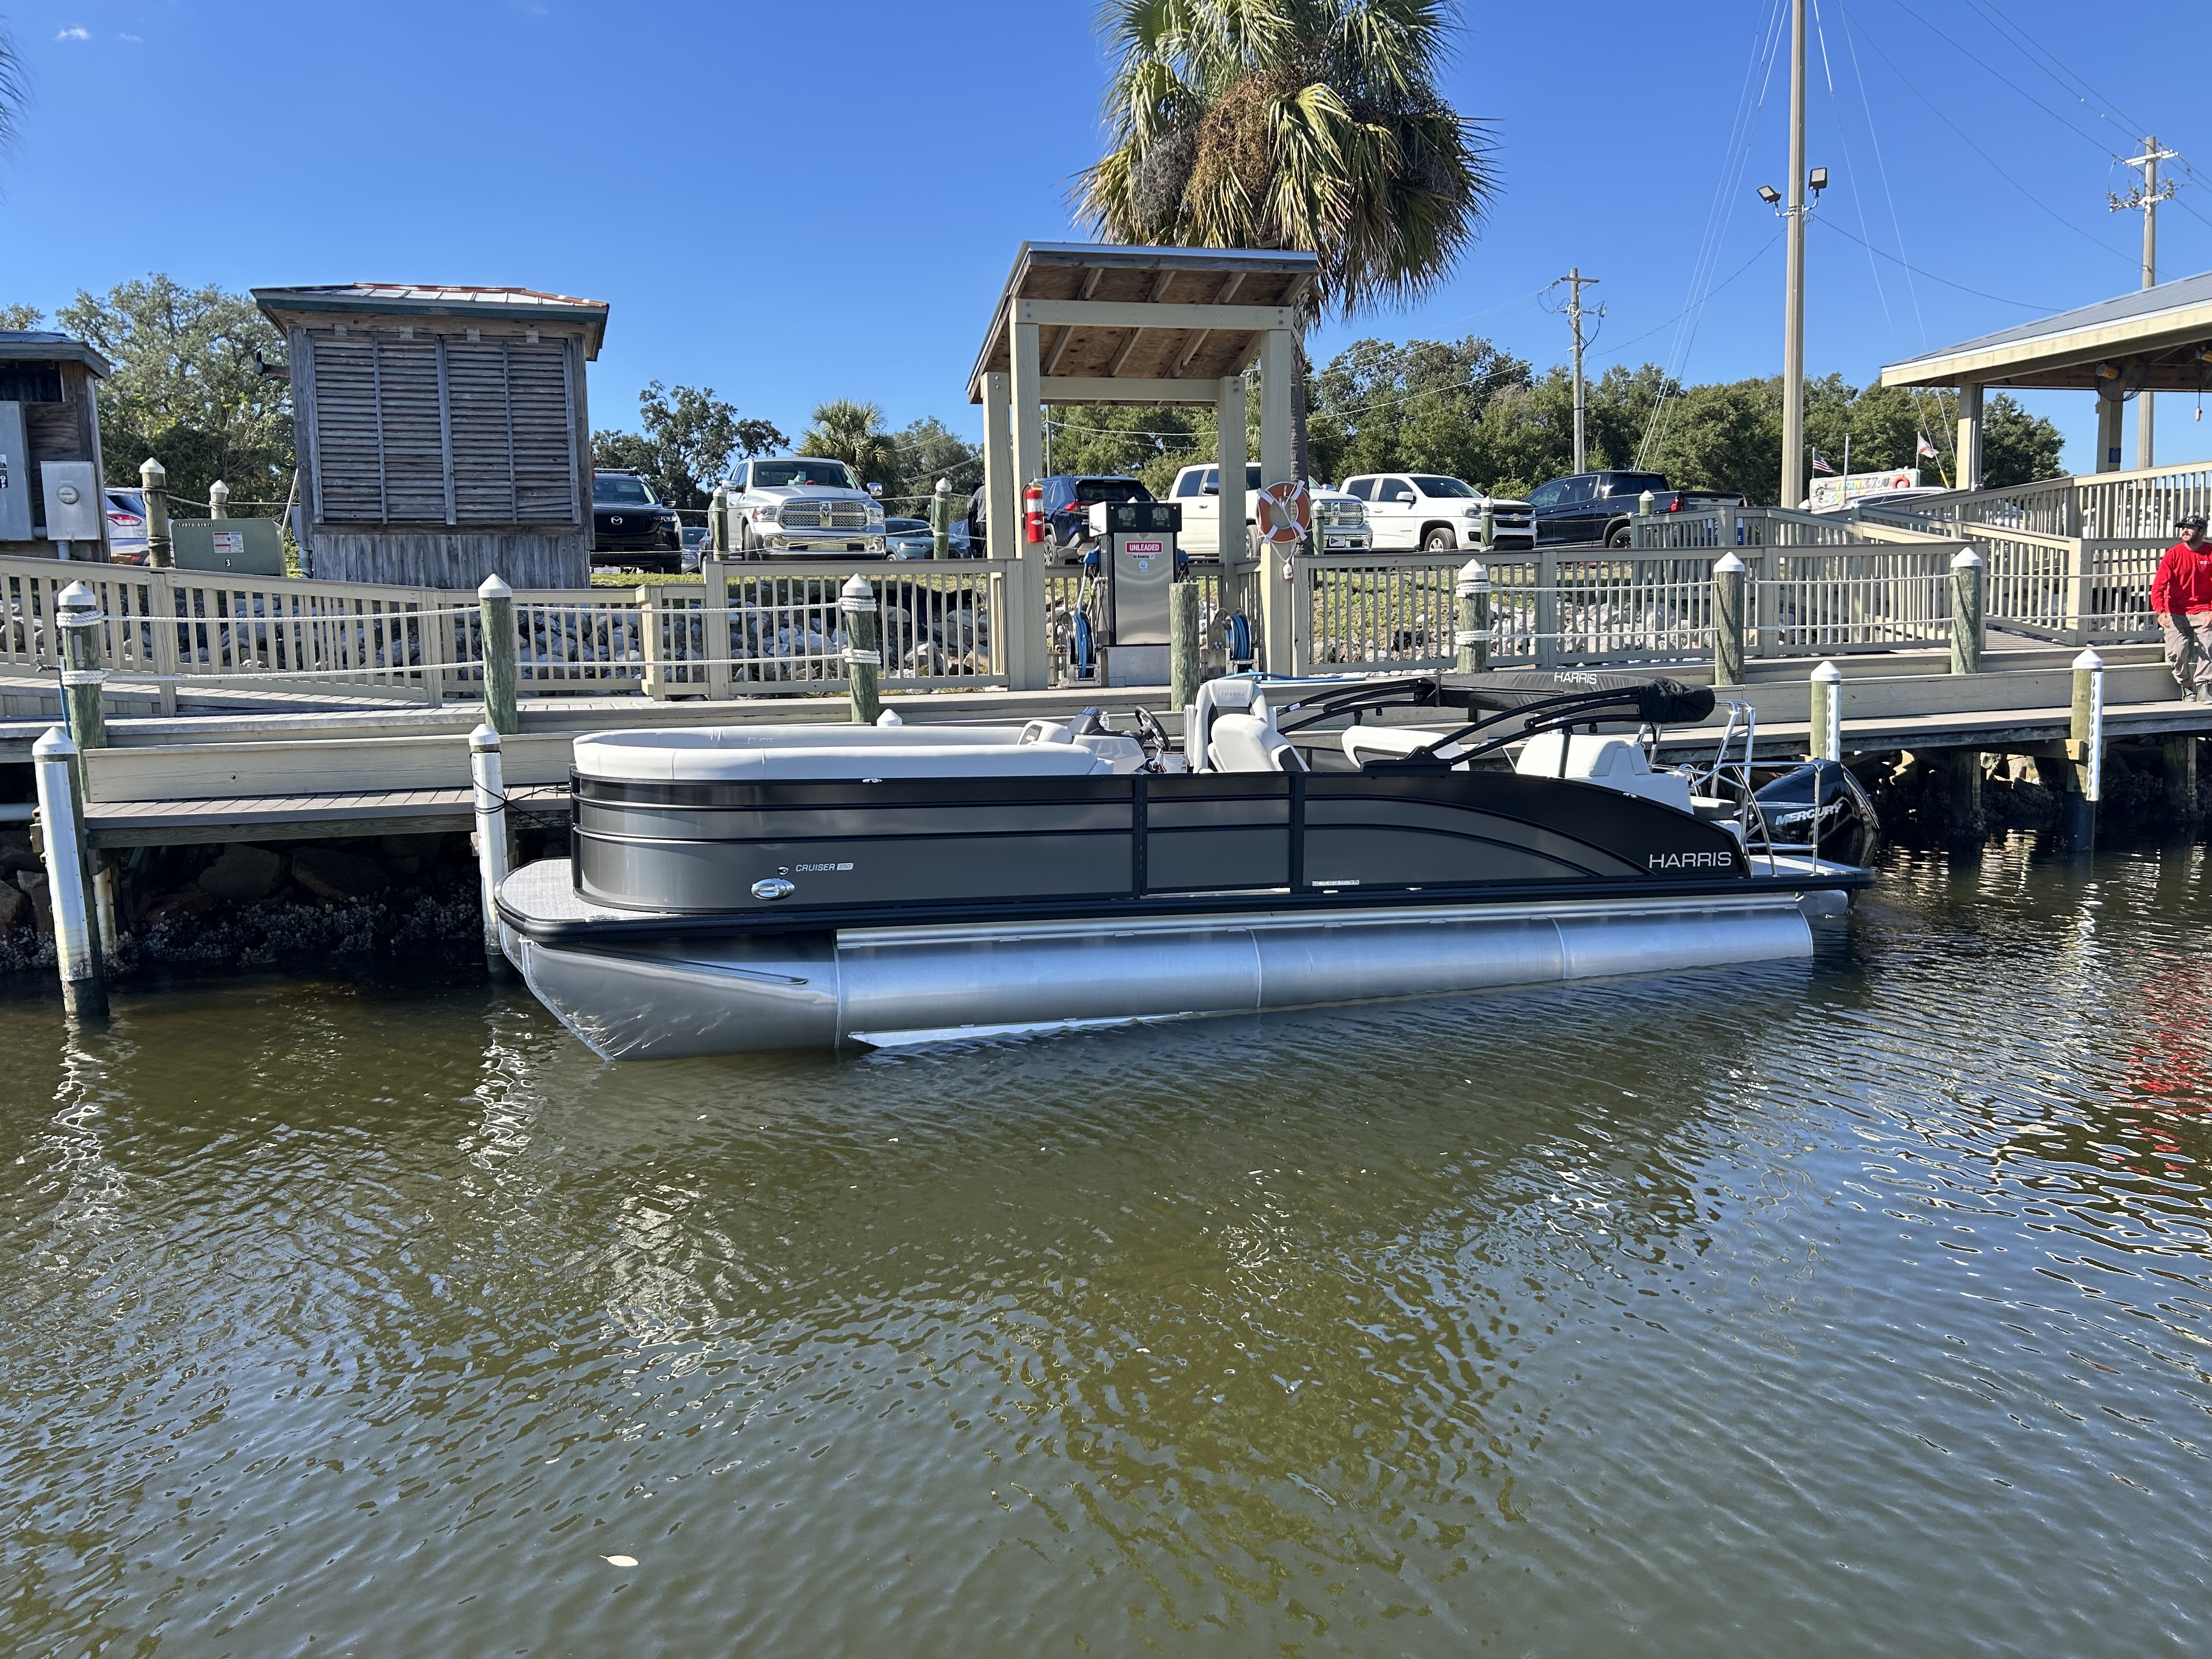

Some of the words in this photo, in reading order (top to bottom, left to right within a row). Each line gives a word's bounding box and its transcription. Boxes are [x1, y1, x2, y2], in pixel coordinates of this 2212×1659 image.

[1835, 478, 1867, 490] THANK
[1869, 477, 1890, 488] YOU
[1554, 671, 1597, 685] HARRIS
[1775, 803, 1843, 825] MERCURY
[1649, 851, 1732, 868] HARRIS
[795, 863, 836, 872] CRUISER
